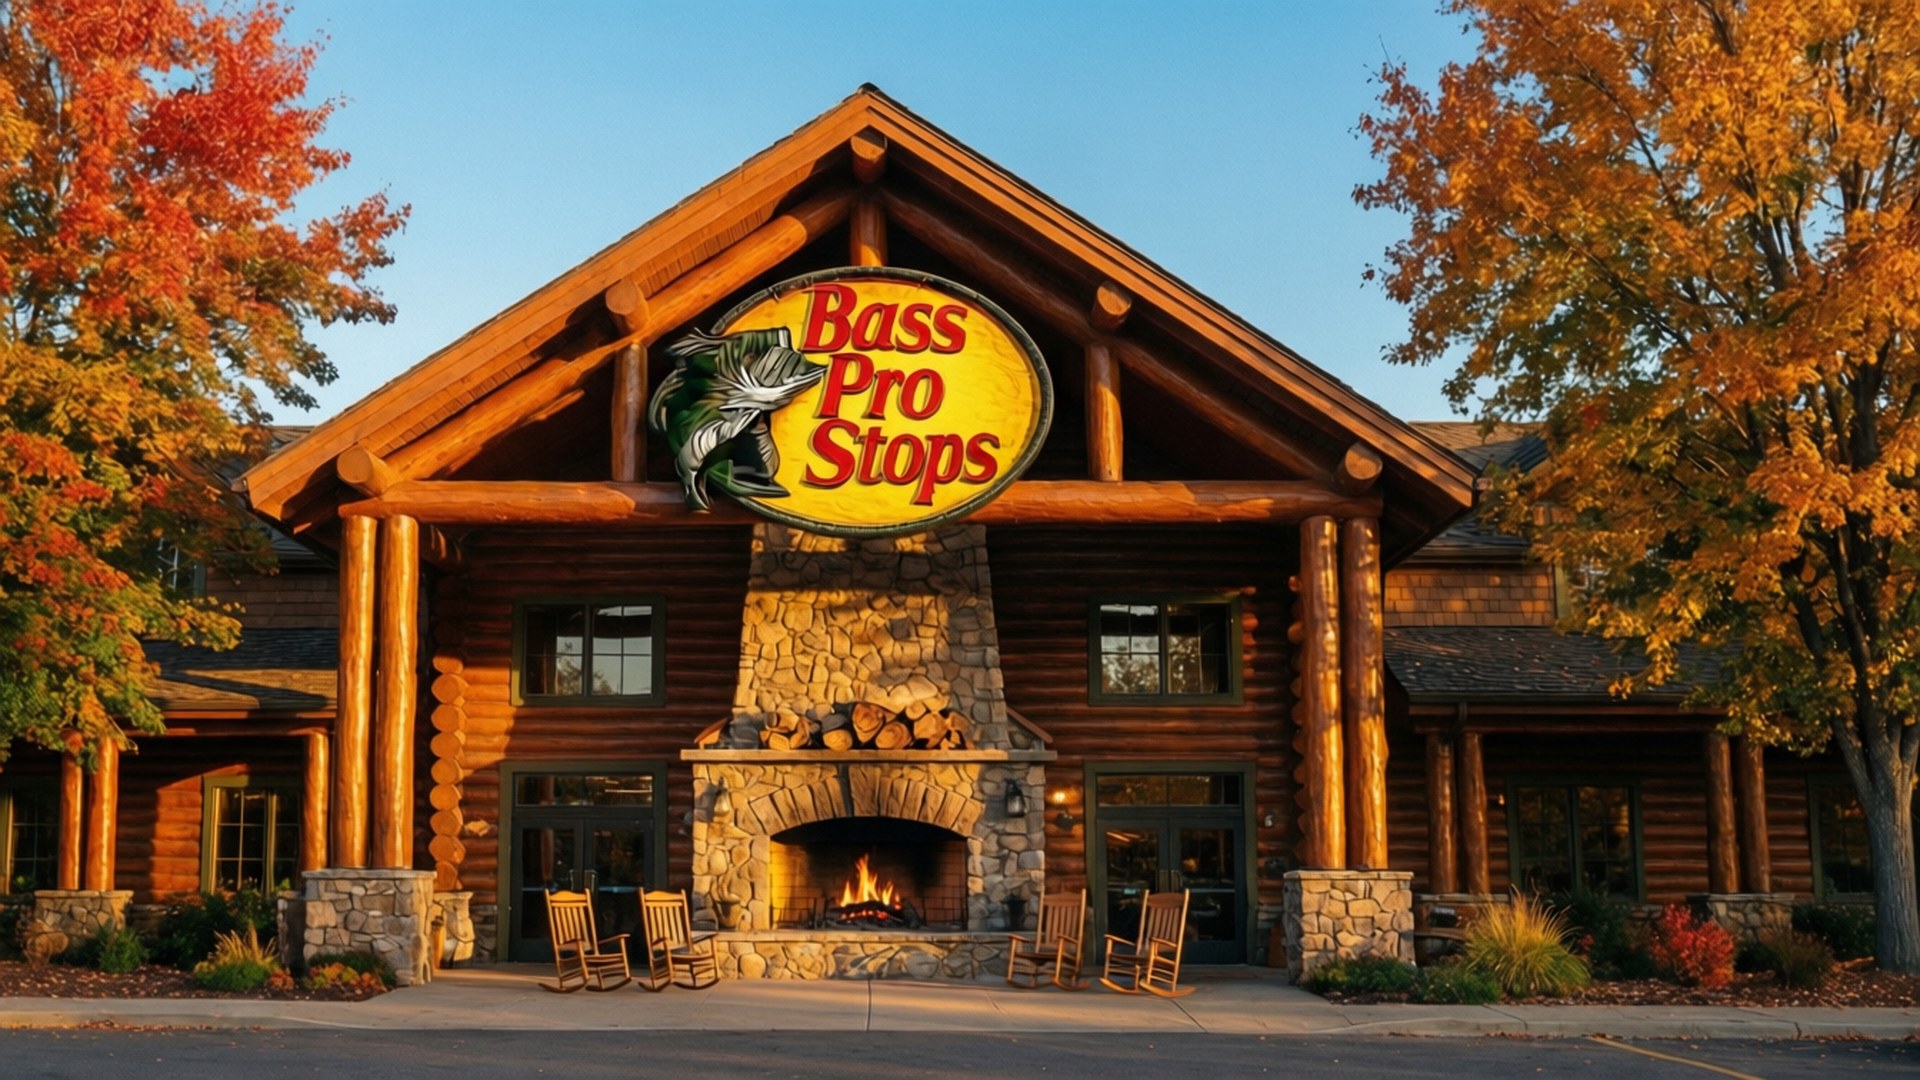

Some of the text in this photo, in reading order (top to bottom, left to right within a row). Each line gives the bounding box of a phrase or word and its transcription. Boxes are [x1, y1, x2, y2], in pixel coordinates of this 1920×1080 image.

[801, 284, 968, 353] Bass
[816, 353, 945, 419] Pro
[802, 419, 1000, 506] Stops
